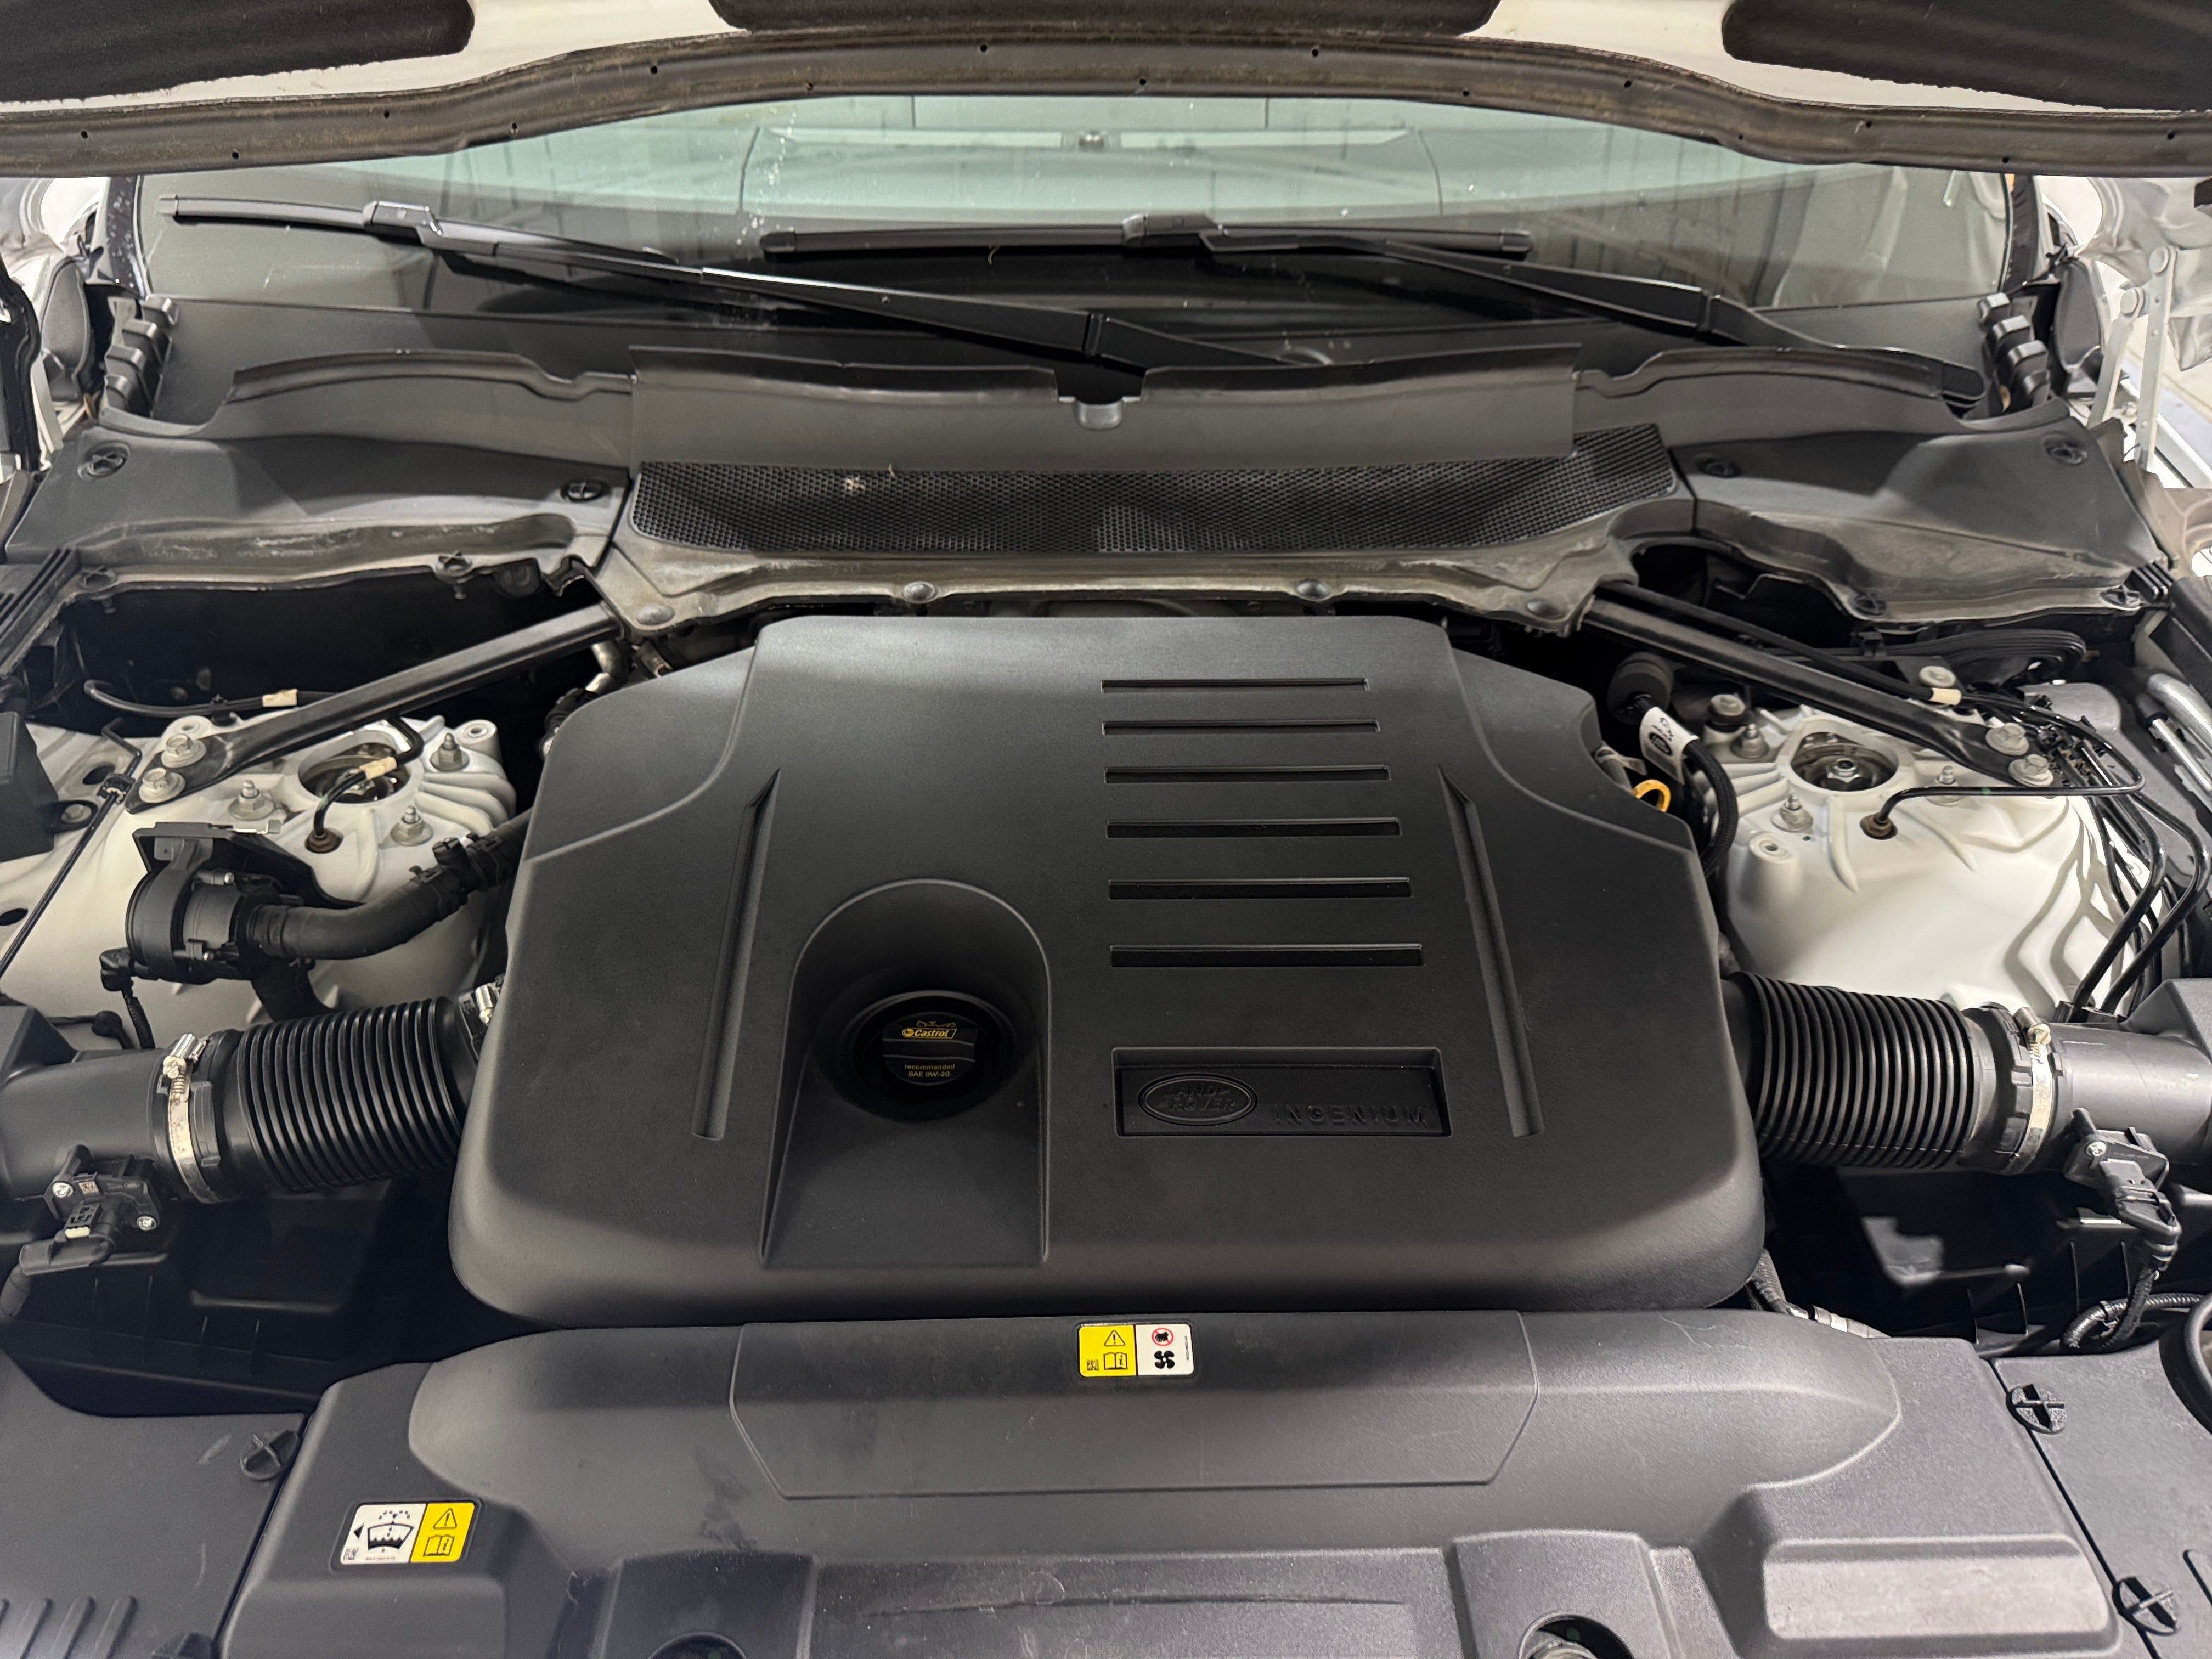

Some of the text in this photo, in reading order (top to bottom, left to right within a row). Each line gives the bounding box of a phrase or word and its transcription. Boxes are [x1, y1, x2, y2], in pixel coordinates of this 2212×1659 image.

[914, 1029, 950, 1037] Castrol
[1169, 1097, 1235, 1111] ROVER
[1272, 1104, 1427, 1124] INGENIUM
